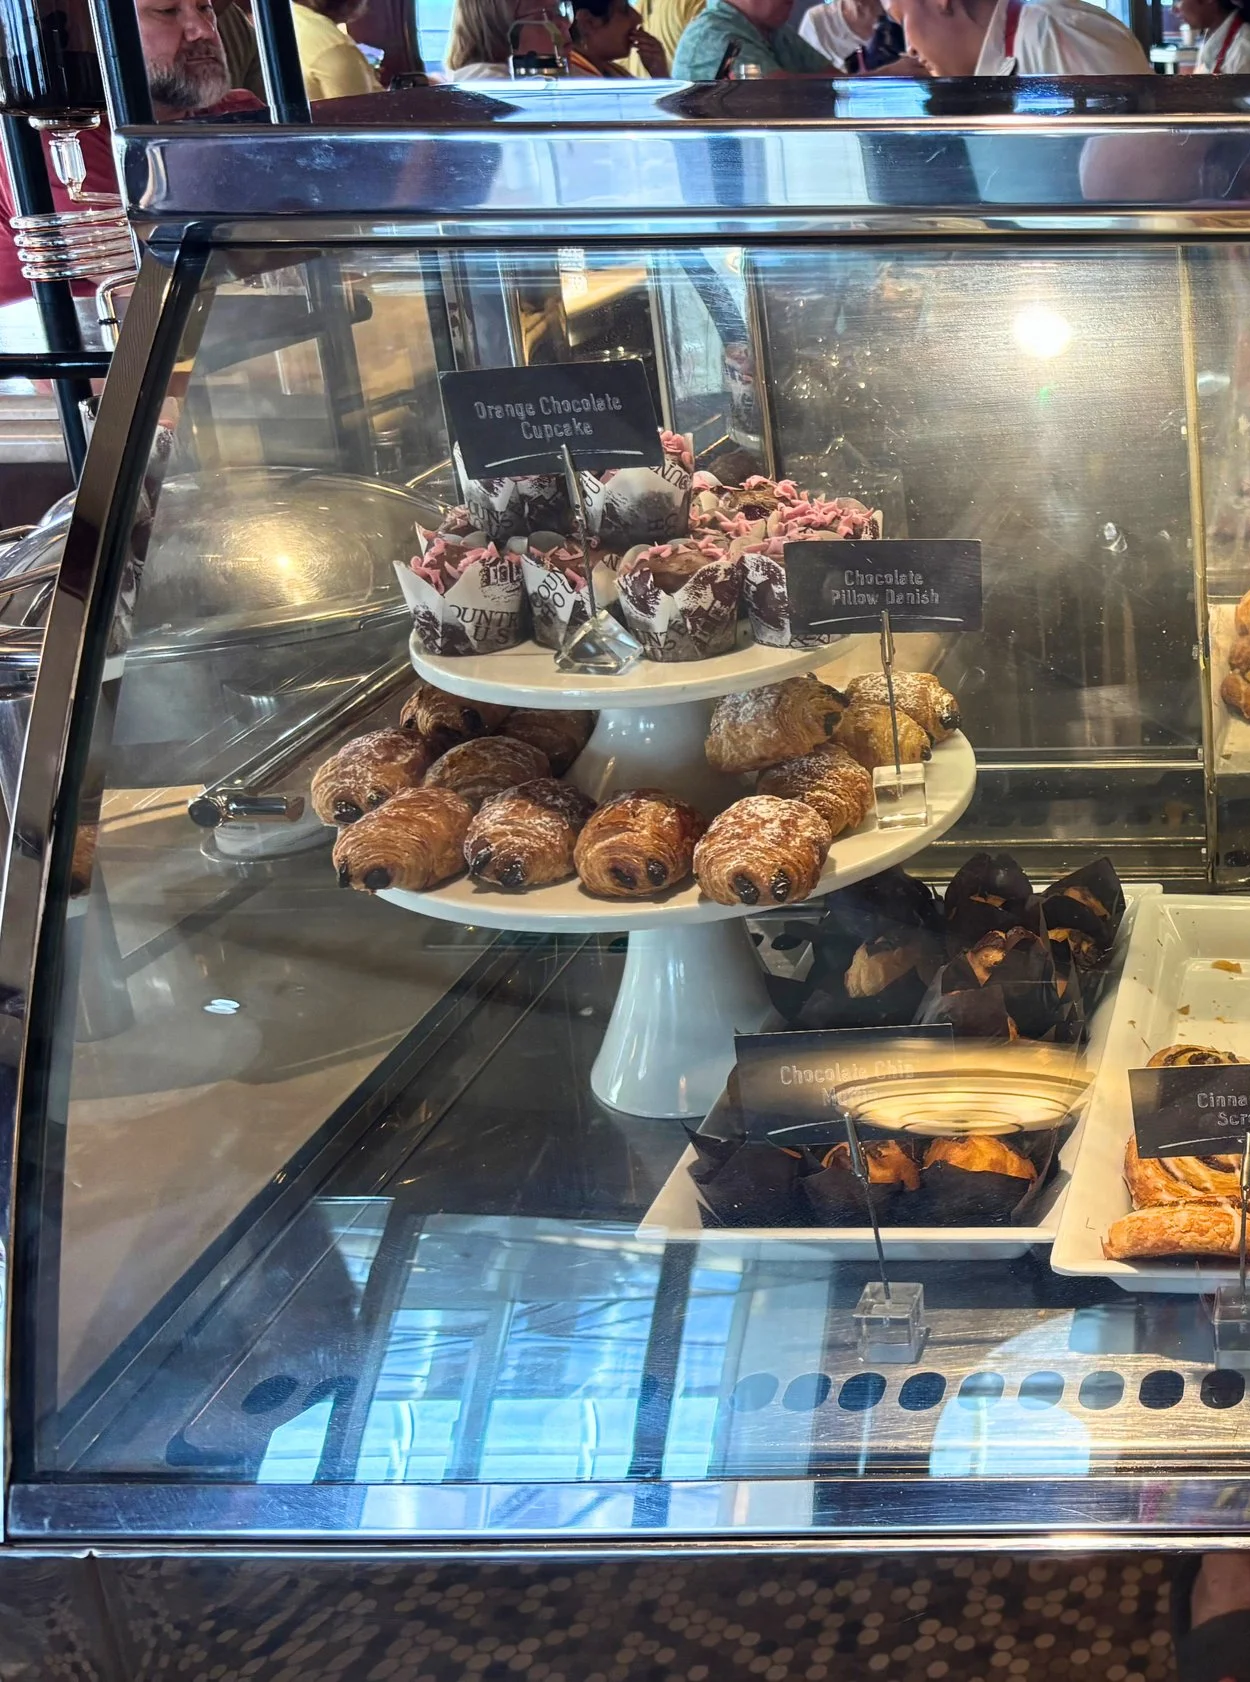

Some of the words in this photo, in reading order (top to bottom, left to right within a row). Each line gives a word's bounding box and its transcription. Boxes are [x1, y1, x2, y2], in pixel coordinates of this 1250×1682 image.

[473, 401, 536, 420] Orange
[539, 393, 623, 415] Chocolate
[520, 417, 594, 442] Cupcake
[844, 569, 924, 586] Chocolate
[831, 589, 880, 606] Pillow
[885, 588, 940, 605] Danish
[780, 1062, 867, 1085] Chocolate
